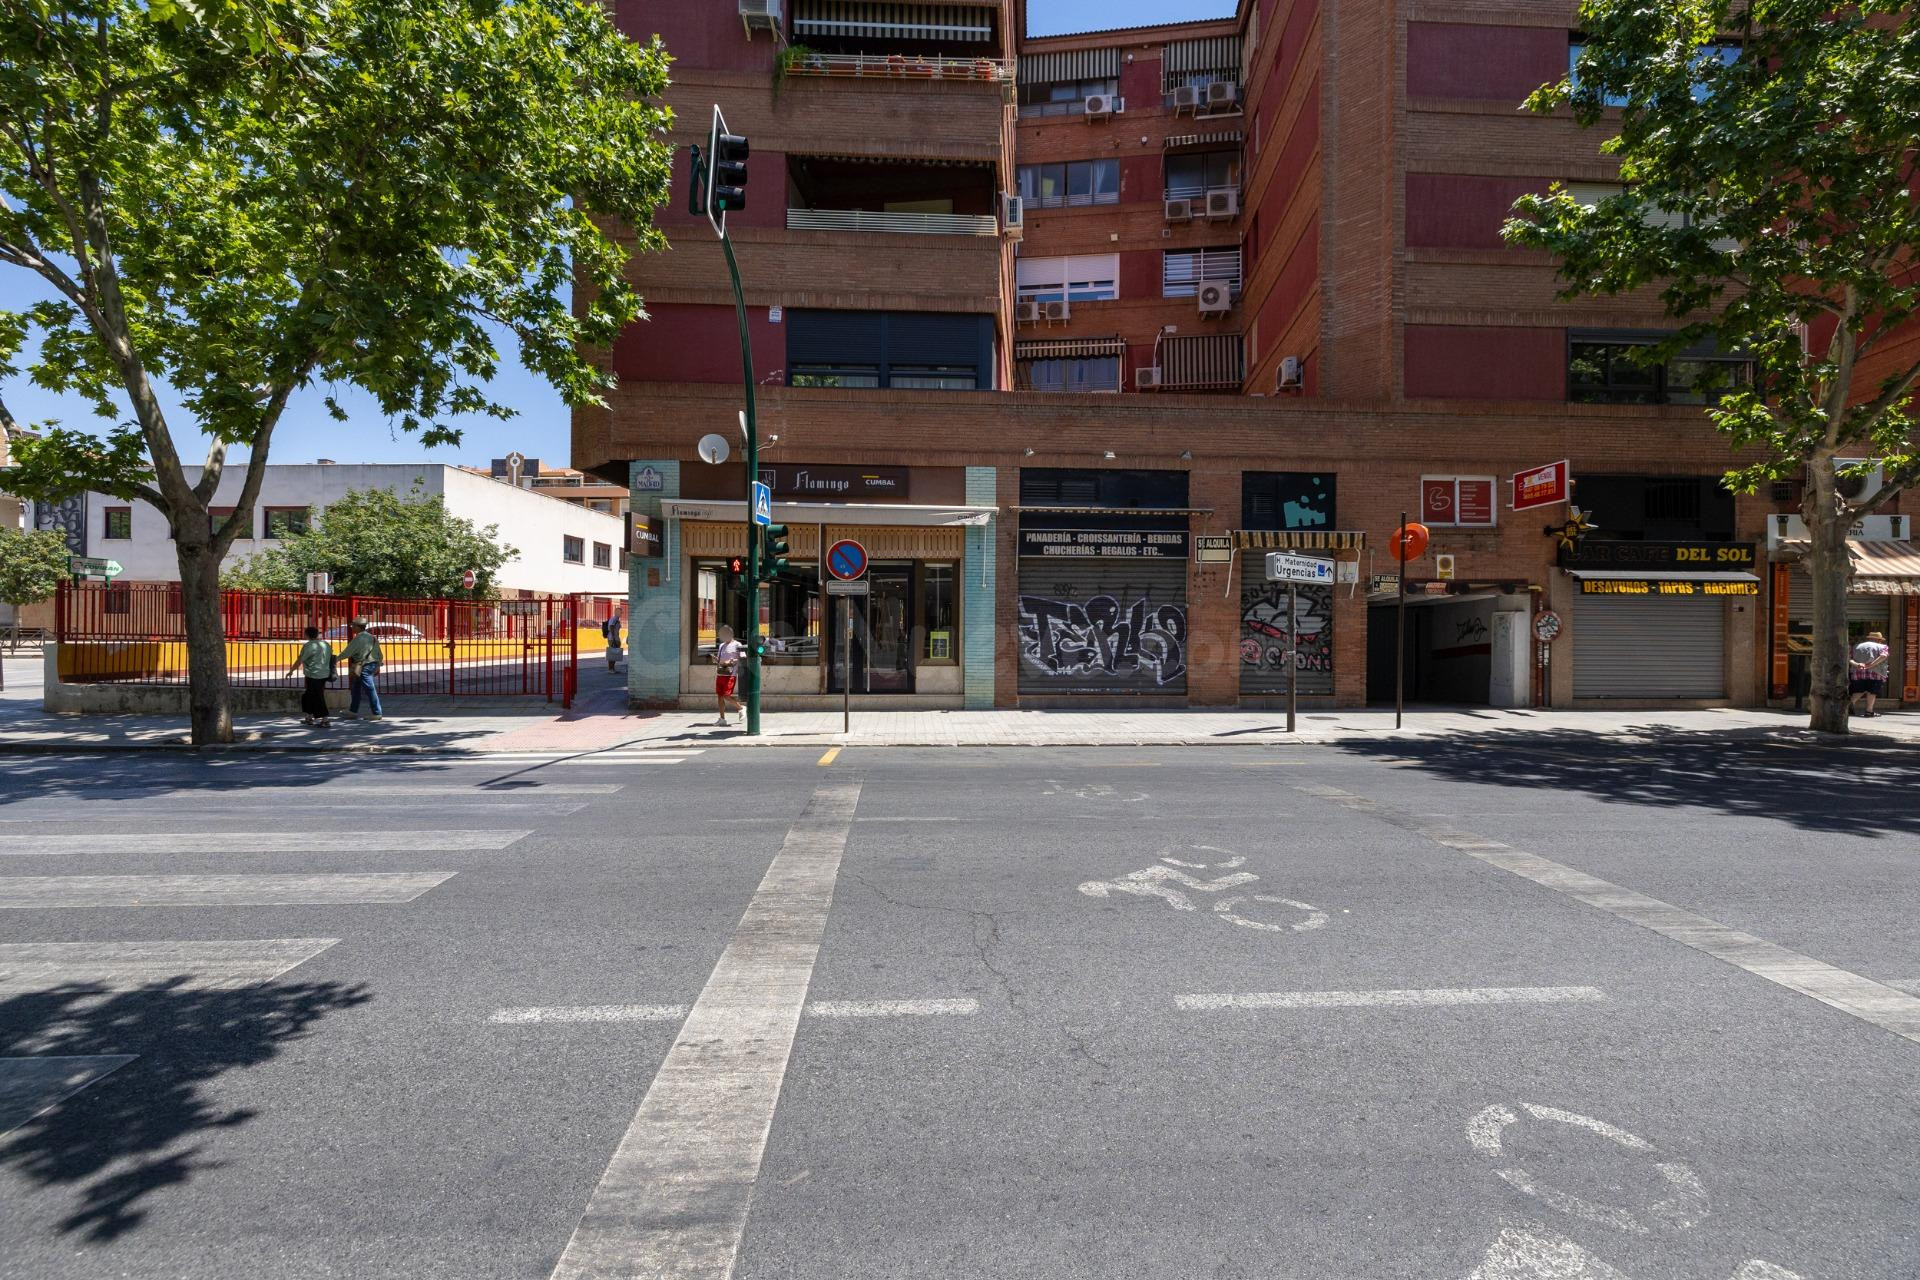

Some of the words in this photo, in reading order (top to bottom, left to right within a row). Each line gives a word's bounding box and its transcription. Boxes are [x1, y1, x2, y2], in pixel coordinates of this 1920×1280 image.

[793, 471, 850, 491] Flamingo
[635, 530, 660, 543] CUMBAL
[1026, 532, 1071, 543] PANADERÍA
[1077, 532, 1141, 544] CROISSANTERÍA
[1147, 534, 1183, 544] BEBIDAS
[1043, 545, 1095, 555] CHUCHERÍAS
[1101, 546, 1137, 556] REGALOS
[1206, 539, 1230, 549] ALQUILA
[1676, 549, 1711, 561] DEL
[1717, 549, 1752, 562] SOL
[1285, 558, 1317, 568] Maternidad
[1276, 565, 1316, 578] Urgencias
[1583, 581, 1649, 593] DESAYUNOS
[1658, 581, 1694, 594] TAPAS
[1704, 582, 1758, 595] RACIONES
